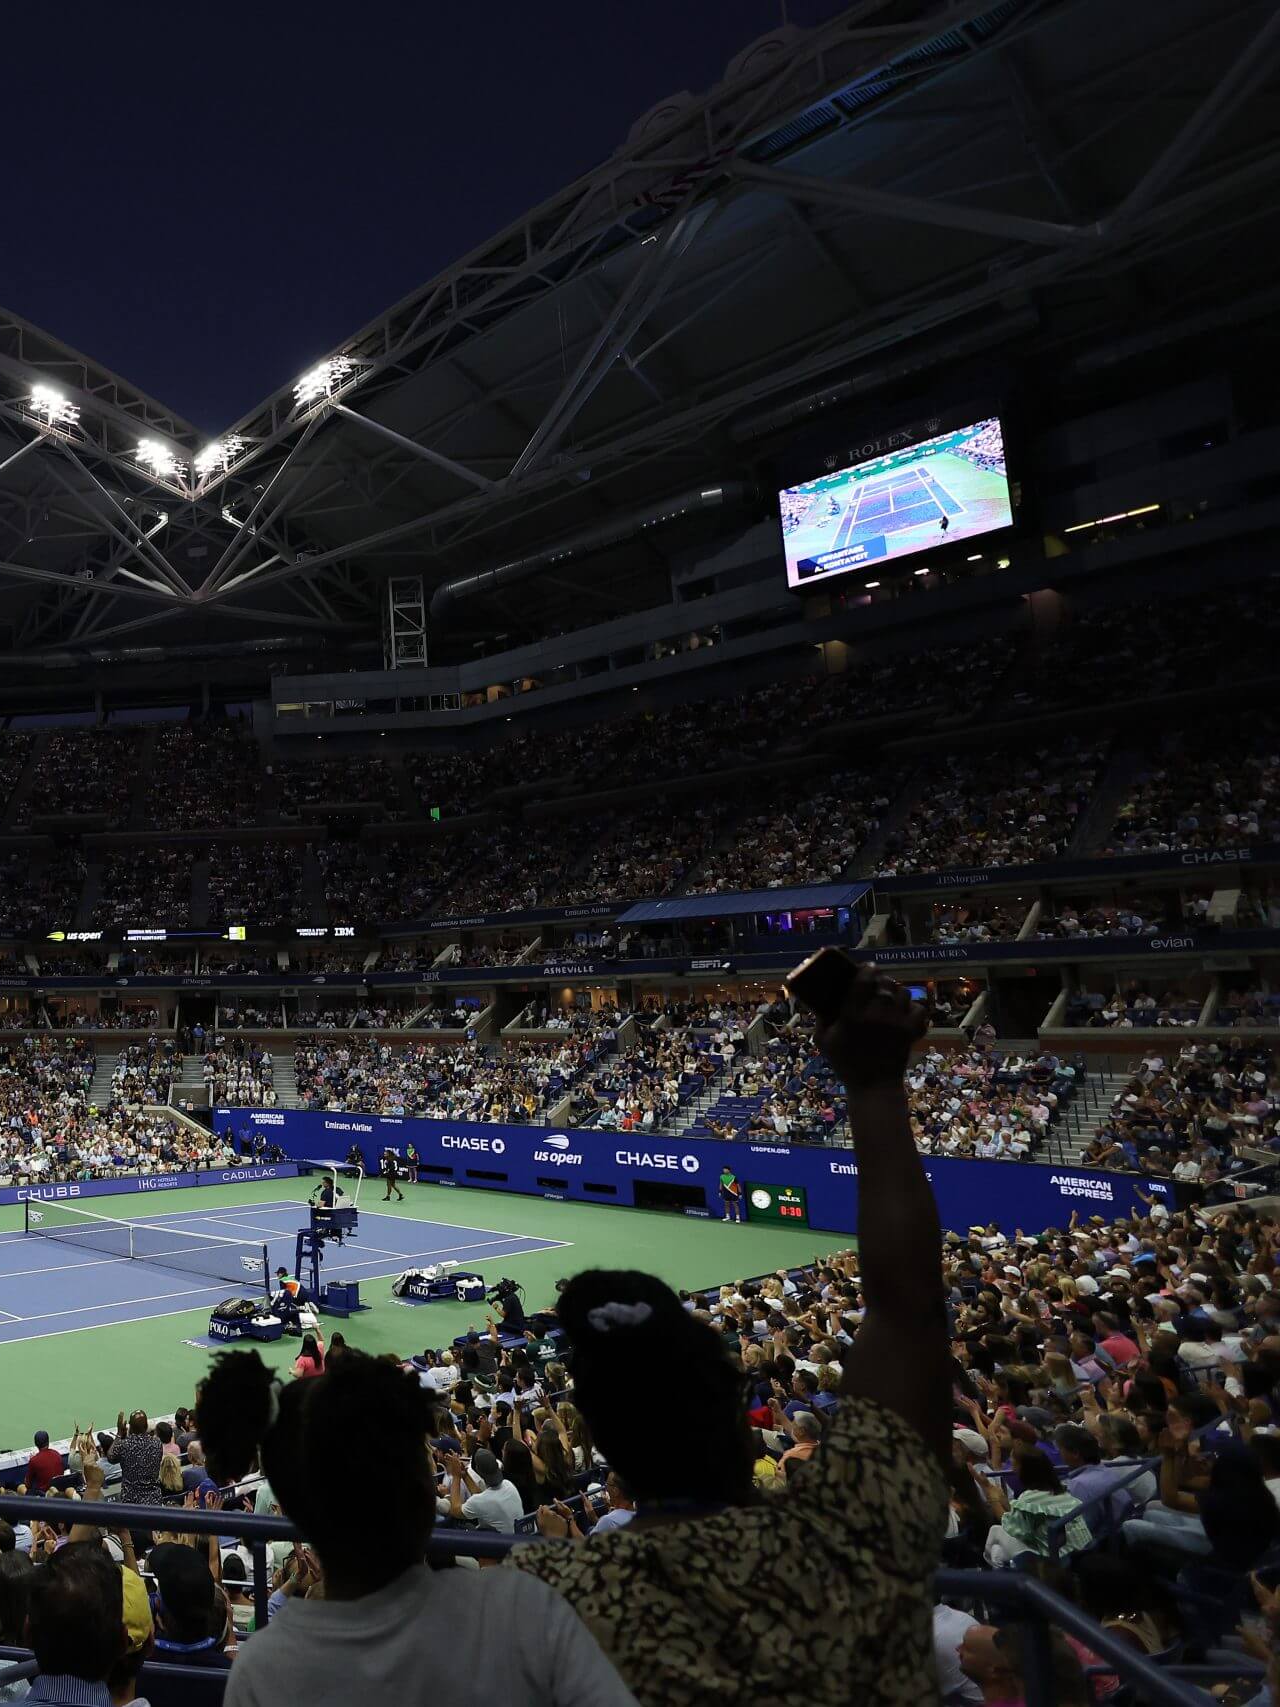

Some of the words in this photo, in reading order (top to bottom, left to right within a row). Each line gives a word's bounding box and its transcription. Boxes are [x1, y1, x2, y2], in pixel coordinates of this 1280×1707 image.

[849, 429, 913, 460] ROLEX
[1181, 849, 1251, 864] CHASE
[564, 909, 589, 917] Emirates
[66, 932, 77, 940] us
[77, 931, 103, 942] open
[334, 928, 354, 936] IBM
[1150, 937, 1194, 949] evian
[875, 952, 898, 961] POLO
[900, 950, 928, 960] RALPH
[930, 949, 968, 959] LAUREN
[543, 964, 595, 975] ASHEVILLE
[422, 972, 440, 982] IBM
[325, 1121, 350, 1131] Emirates
[352, 1123, 372, 1132] Airline
[441, 1135, 489, 1151] CHASE
[750, 1146, 790, 1155] USOPEN.ORG
[534, 1151, 548, 1162] us
[549, 1153, 582, 1166] open
[616, 1151, 679, 1170] CHASE
[222, 1168, 276, 1181] CADILLAC
[138, 1179, 156, 1189] IHG
[1050, 1176, 1111, 1191] AMERICAN
[1148, 1183, 1167, 1193] USTA
[17, 1186, 80, 1200] CHUBB
[778, 1195, 800, 1203] ROLEX
[1060, 1187, 1114, 1200] EXPRESS
[780, 1206, 802, 1217] 0:30
[409, 1284, 428, 1296] POLO
[210, 1321, 228, 1335] POLO
